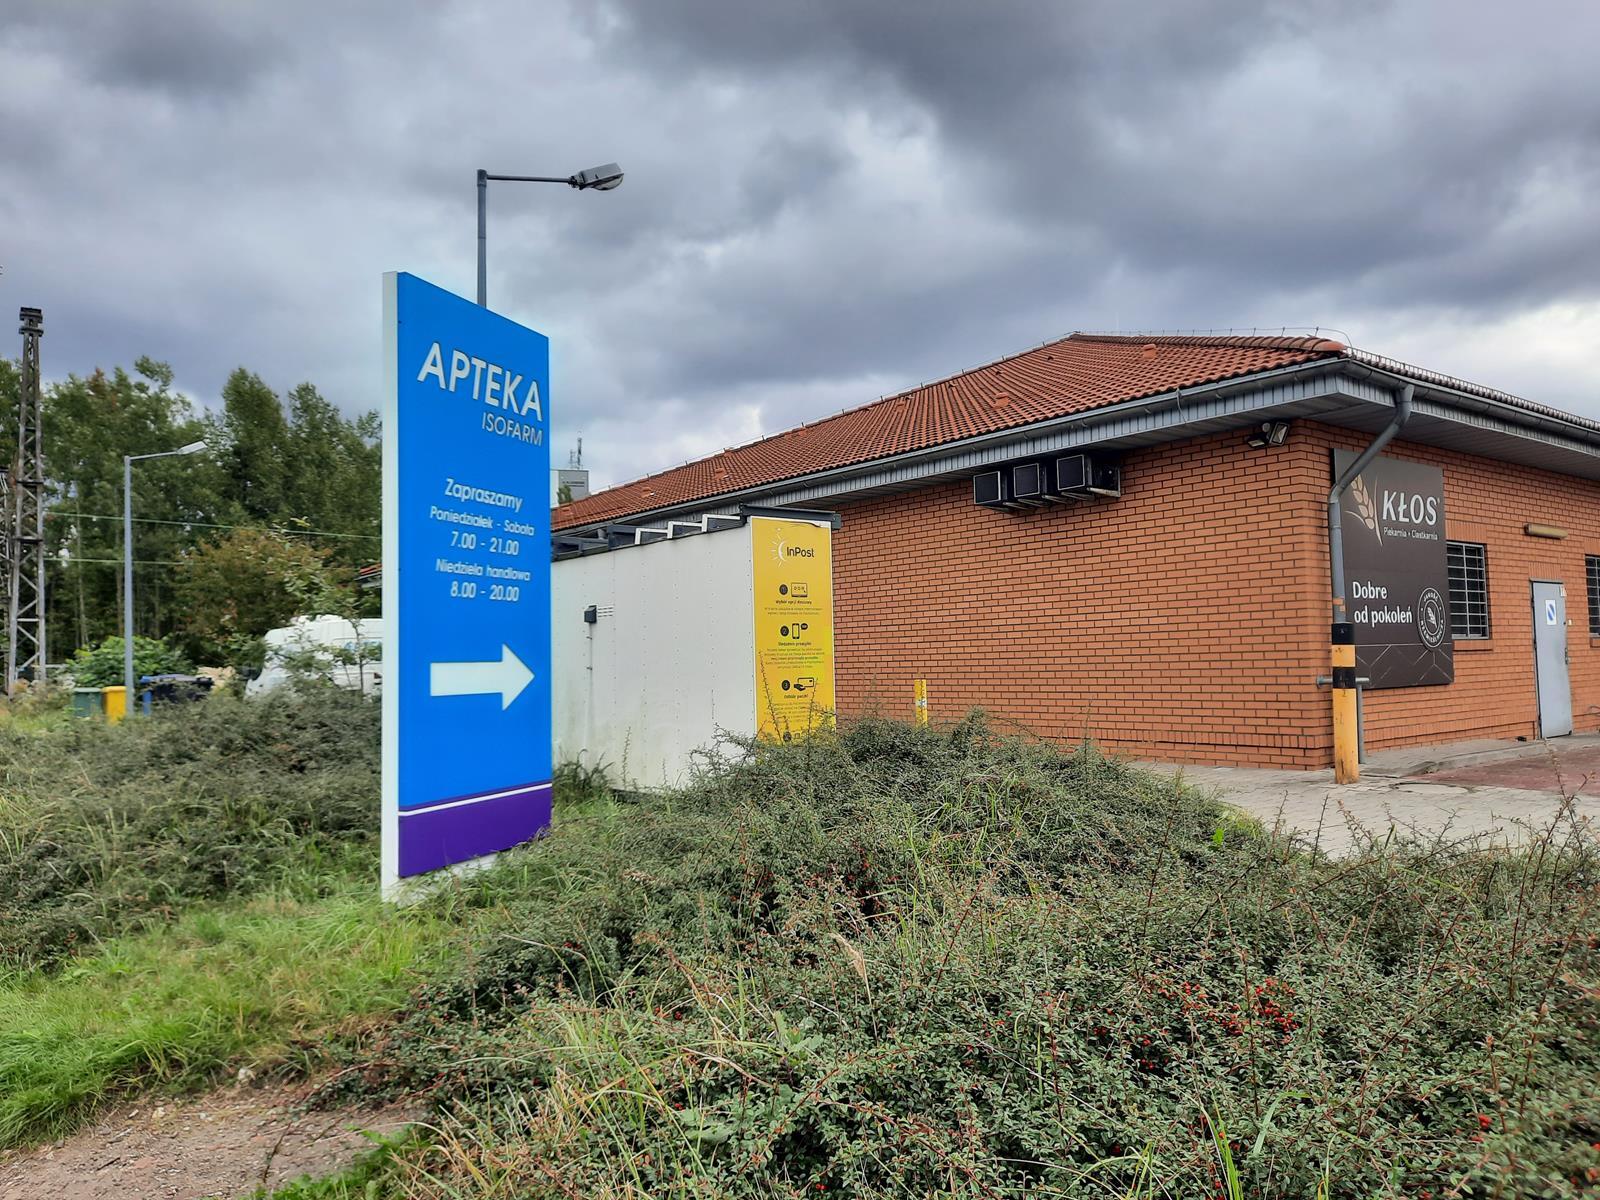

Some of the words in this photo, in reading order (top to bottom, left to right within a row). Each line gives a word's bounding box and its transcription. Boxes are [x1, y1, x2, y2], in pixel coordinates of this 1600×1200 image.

[417, 342, 543, 422] APTEKA
[482, 412, 543, 447] ISOFARM
[444, 478, 523, 513] Zapraszamy
[1382, 490, 1437, 526] KŁOS
[503, 519, 536, 537] Sobota
[1383, 526, 1407, 538] Piekarnia
[1411, 529, 1438, 541] Ciastkarnia
[450, 531, 477, 550] 7.00
[489, 537, 520, 556] 21.00
[786, 546, 815, 558] InPost
[435, 558, 484, 576] Niedziela
[486, 564, 532, 582] handlowa
[450, 580, 477, 599] 8.00
[489, 584, 520, 602] 20.00
[1352, 580, 1388, 600] Dobre
[1354, 605, 1369, 624] od
[1371, 605, 1413, 628] pokoleń
